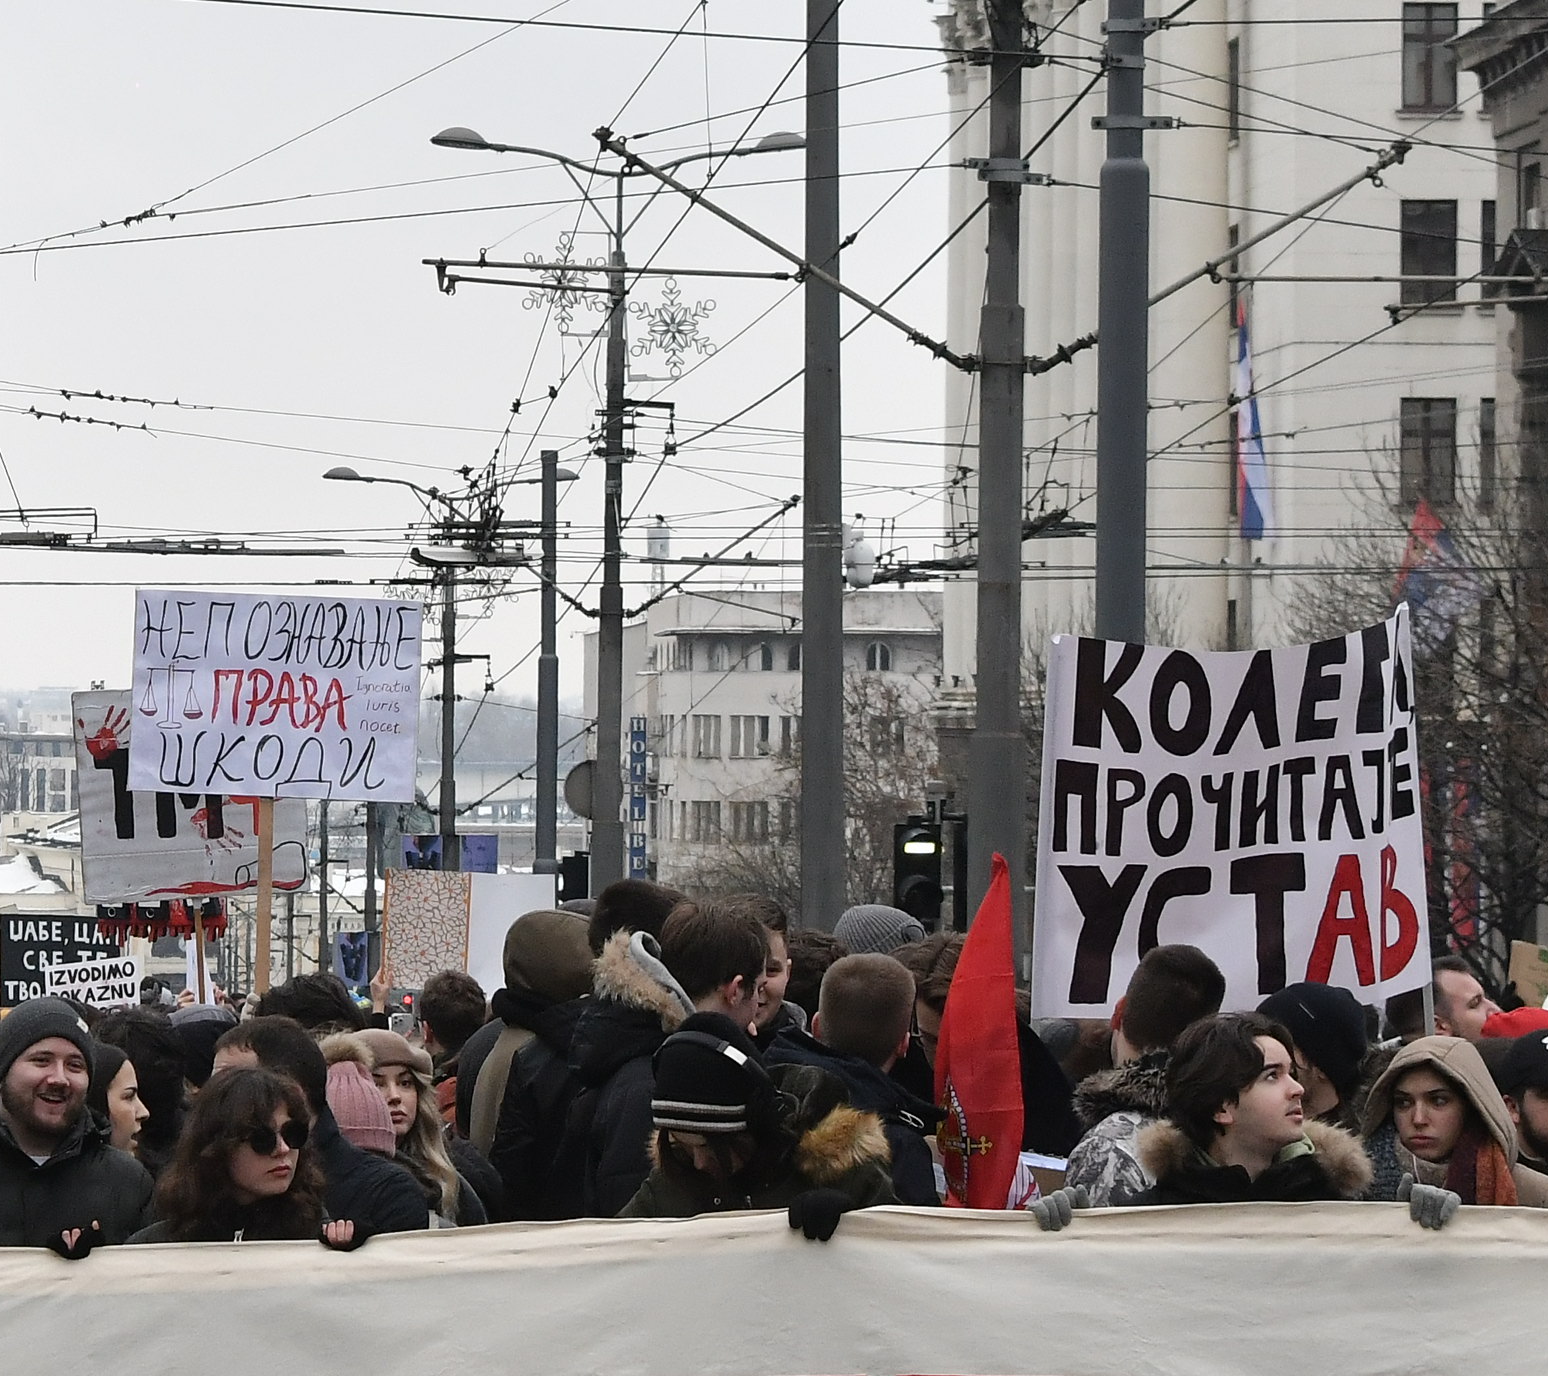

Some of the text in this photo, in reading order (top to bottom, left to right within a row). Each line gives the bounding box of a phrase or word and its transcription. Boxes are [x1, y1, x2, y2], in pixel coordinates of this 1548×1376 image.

[212, 669, 353, 732] ПРАВА
[160, 731, 385, 800] ШКОДИ
[632, 719, 645, 820] HOTEL
[1057, 844, 1419, 1004] УСТАВ
[50, 961, 135, 986] IZVODIMO
